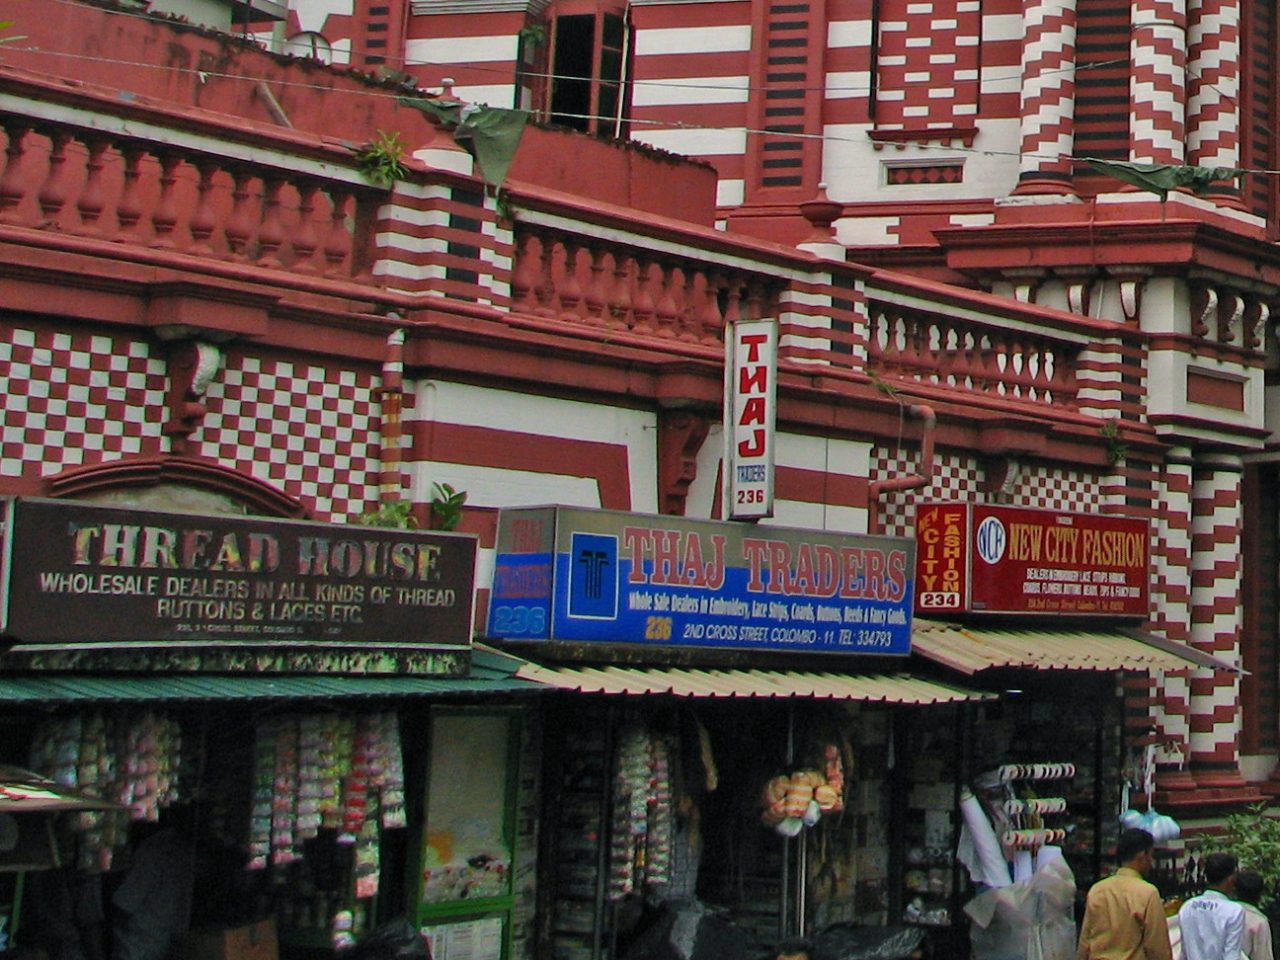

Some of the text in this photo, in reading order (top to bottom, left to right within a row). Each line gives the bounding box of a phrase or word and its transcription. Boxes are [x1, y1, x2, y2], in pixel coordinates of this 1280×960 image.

[737, 334, 768, 457] THAJ
[737, 464, 766, 482] TRADERS
[737, 489, 764, 504] 236
[67, 521, 280, 573] THREAD
[298, 536, 442, 582] HOUSE
[918, 507, 961, 592] NEW CITY FASHION
[1009, 523, 1145, 568] NEW CITY FASHION
[624, 526, 727, 591] THAJ
[743, 538, 907, 603] TRADERS
[40, 572, 456, 608] WHOLESALE DEALERS IN ALL KINDS OF THREAD
[924, 594, 956, 607] 234
[157, 598, 245, 621] BUTTONS
[251, 602, 264, 621] &
[270, 603, 326, 623] LACES
[495, 605, 546, 634] 236
[645, 614, 673, 640] 236
[683, 623, 705, 640] 2ND
[705, 624, 738, 641] CROSS
[770, 627, 816, 644] COLOMBO
[857, 630, 892, 648] 334793
